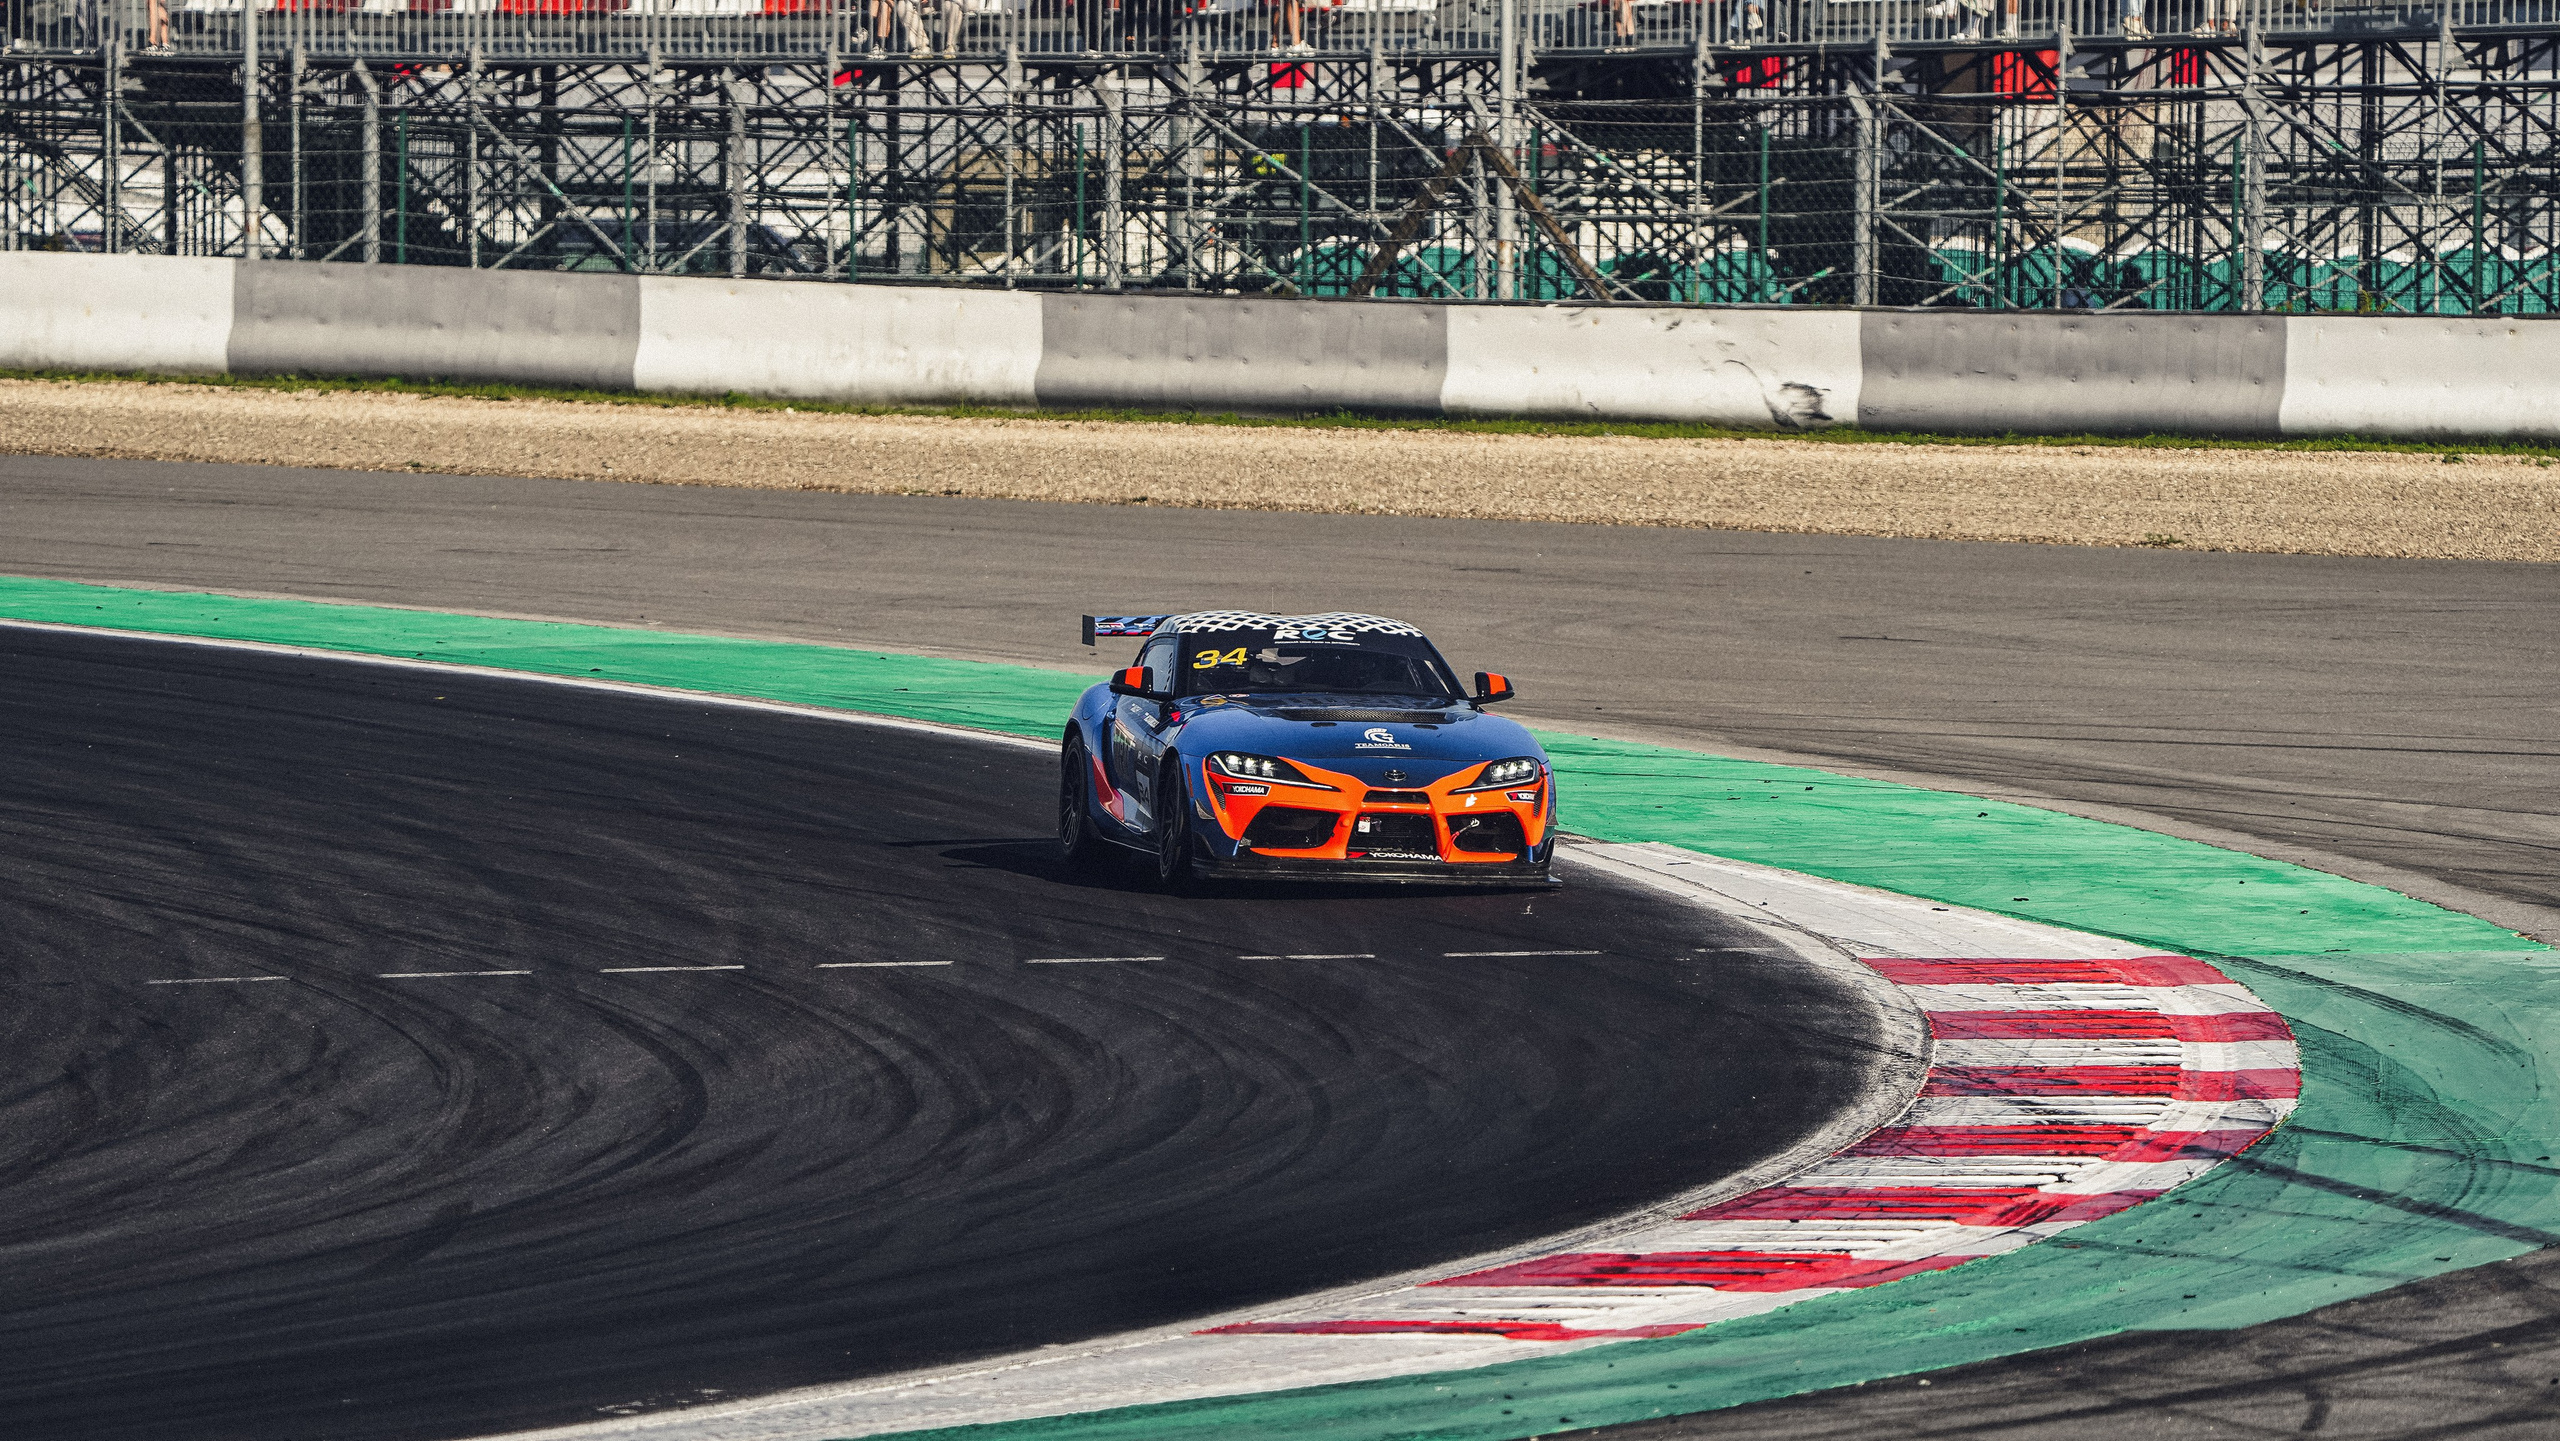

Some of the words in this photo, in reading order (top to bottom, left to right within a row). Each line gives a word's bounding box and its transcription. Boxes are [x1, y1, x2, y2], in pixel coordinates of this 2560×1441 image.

[1193, 647, 1248, 669] 34
[1232, 785, 1265, 794] YOKOHAMA
[1369, 851, 1444, 862] YOKOHAMA
